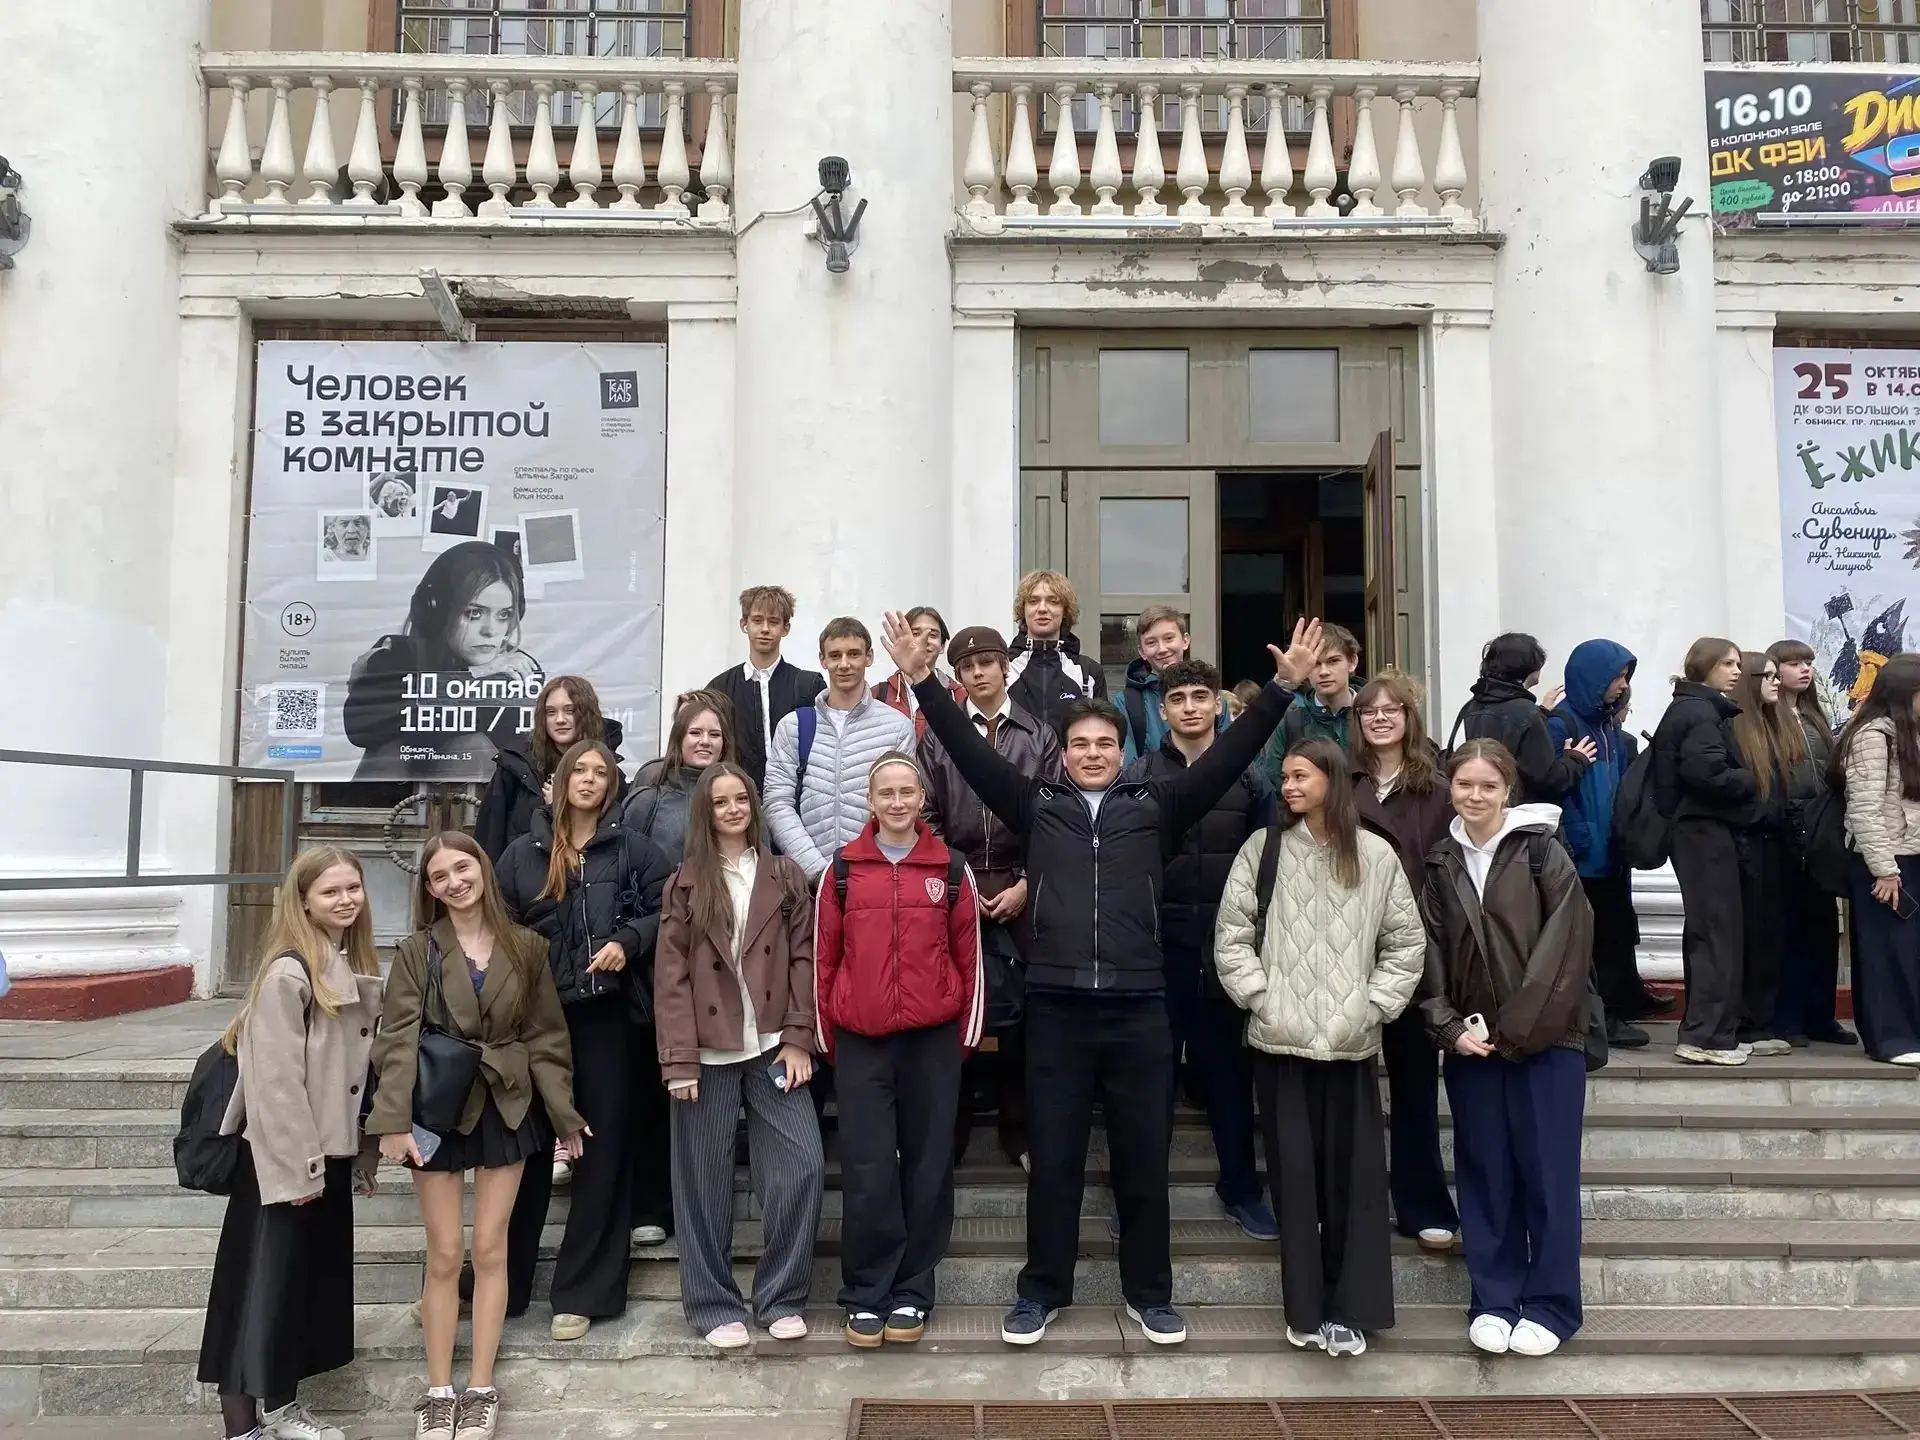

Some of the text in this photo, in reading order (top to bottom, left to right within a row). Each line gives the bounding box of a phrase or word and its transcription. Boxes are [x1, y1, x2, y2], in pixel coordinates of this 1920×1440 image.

[1714, 84, 1813, 130] 16.10
[1721, 127, 1789, 146] КОЛОННОМ
[1791, 121, 1823, 135] ЗАЛЕ
[1711, 136, 1827, 176] ДК ФЭИ
[1796, 166, 1841, 184] 18:00
[1719, 194, 1739, 206] 400
[1781, 181, 1851, 213] до 21:00
[286, 364, 466, 402] Человек
[1793, 362, 1852, 400] 25
[1866, 382, 1878, 397] В
[1793, 405, 1809, 416] ДК
[1814, 404, 1842, 415] ФЭИ
[1846, 404, 1909, 416] БОЛЬШОЙ
[285, 401, 550, 446] в закрытой
[283, 446, 485, 473] комнате
[513, 492, 534, 500] Юлия
[1811, 501, 1879, 516] Ансамбль
[1792, 516, 1897, 551] «Сувенир»
[1807, 546, 1882, 564] рук. Никита
[1824, 559, 1874, 576] Липунов
[287, 613, 312, 626] 18+
[400, 673, 544, 699] 10 октяб
[400, 706, 477, 732] 18:00
[515, 706, 535, 734] Д
[462, 752, 472, 760] 15
